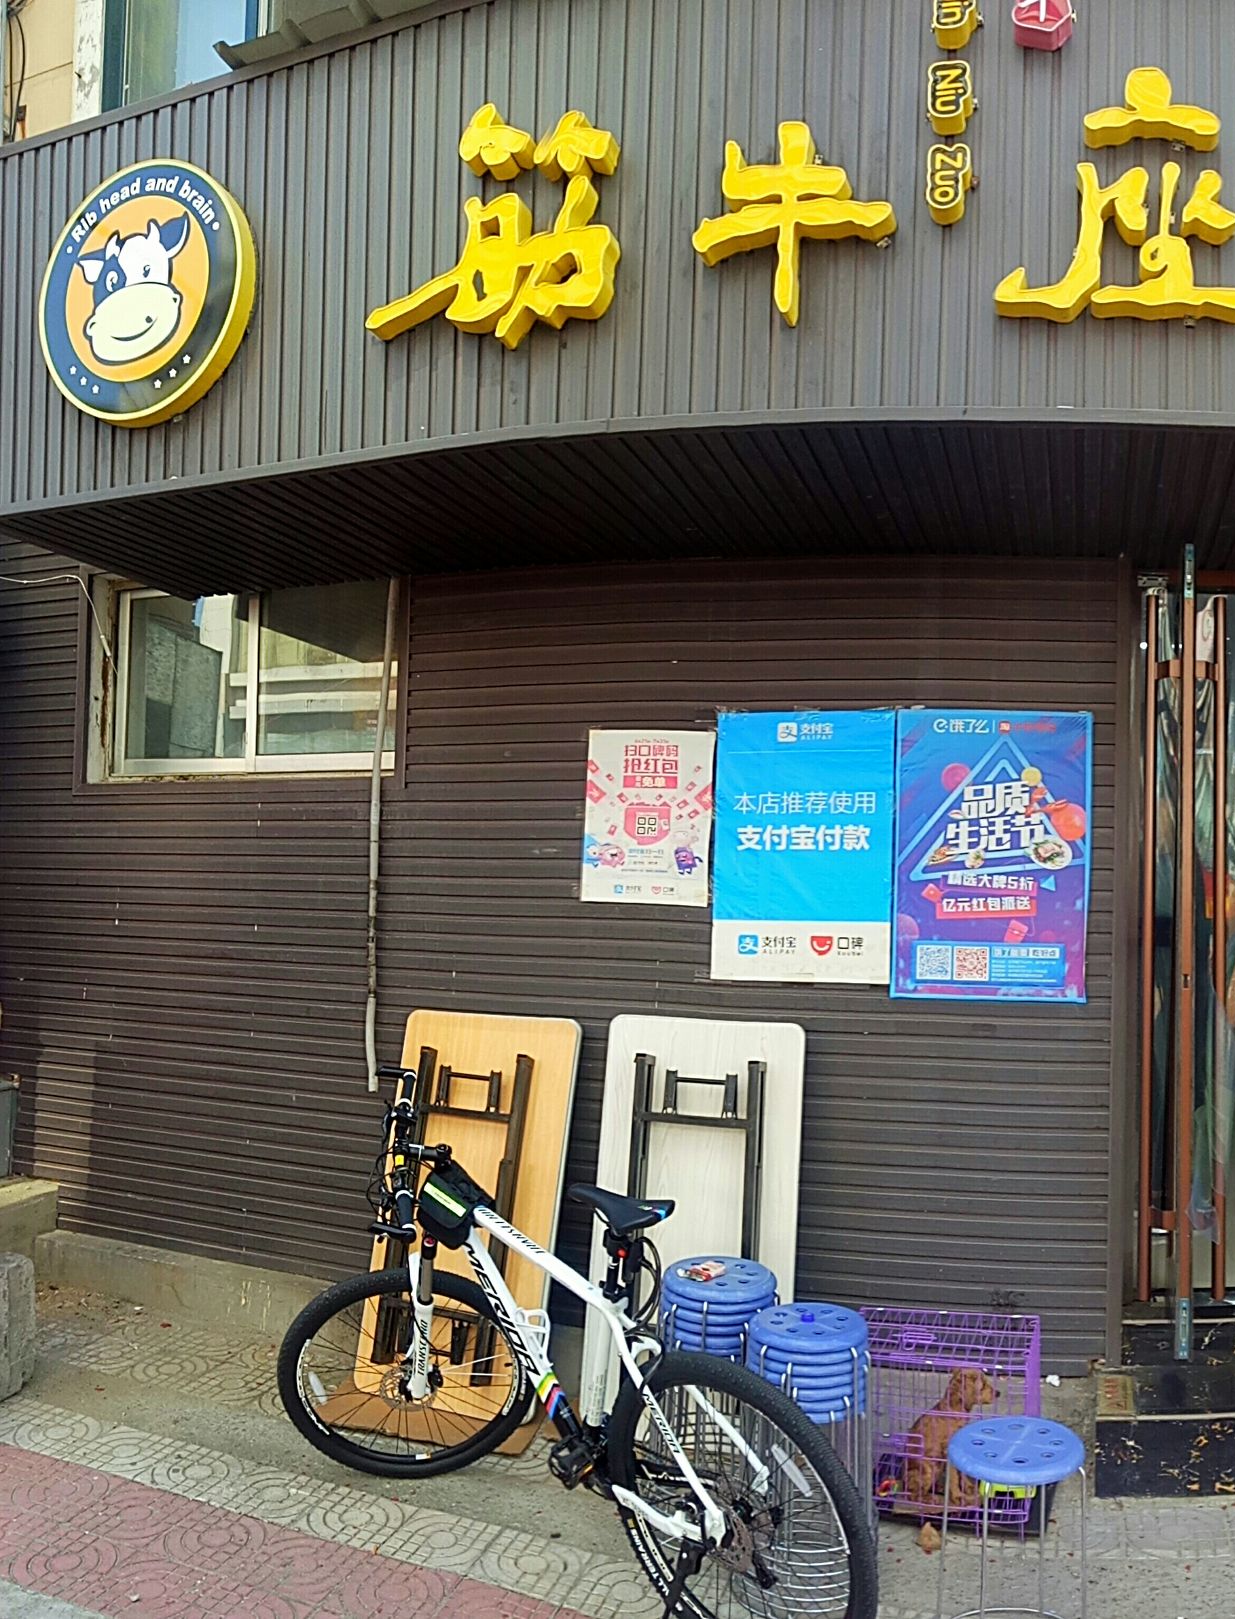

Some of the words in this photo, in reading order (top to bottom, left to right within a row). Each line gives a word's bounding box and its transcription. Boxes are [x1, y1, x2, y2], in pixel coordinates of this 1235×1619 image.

[940, 0, 970, 23] in
[935, 68, 964, 111] Niu
[934, 152, 963, 202] Zuo
[99, 177, 141, 214] head
[144, 175, 179, 193] and
[178, 180, 216, 225] brain
[800, 723, 834, 734] 支付宝
[623, 758, 678, 774] 抢红包
[733, 790, 876, 815] 本店推荐使用
[961, 780, 1031, 820] 品质
[736, 824, 871, 851] 支付宝付款
[946, 812, 1045, 852] 生活节
[761, 936, 797, 948] 支付宝
[837, 937, 864, 949] 口碑
[463, 1243, 541, 1376] MERIDA
[643, 1393, 680, 1454] MERIDA
